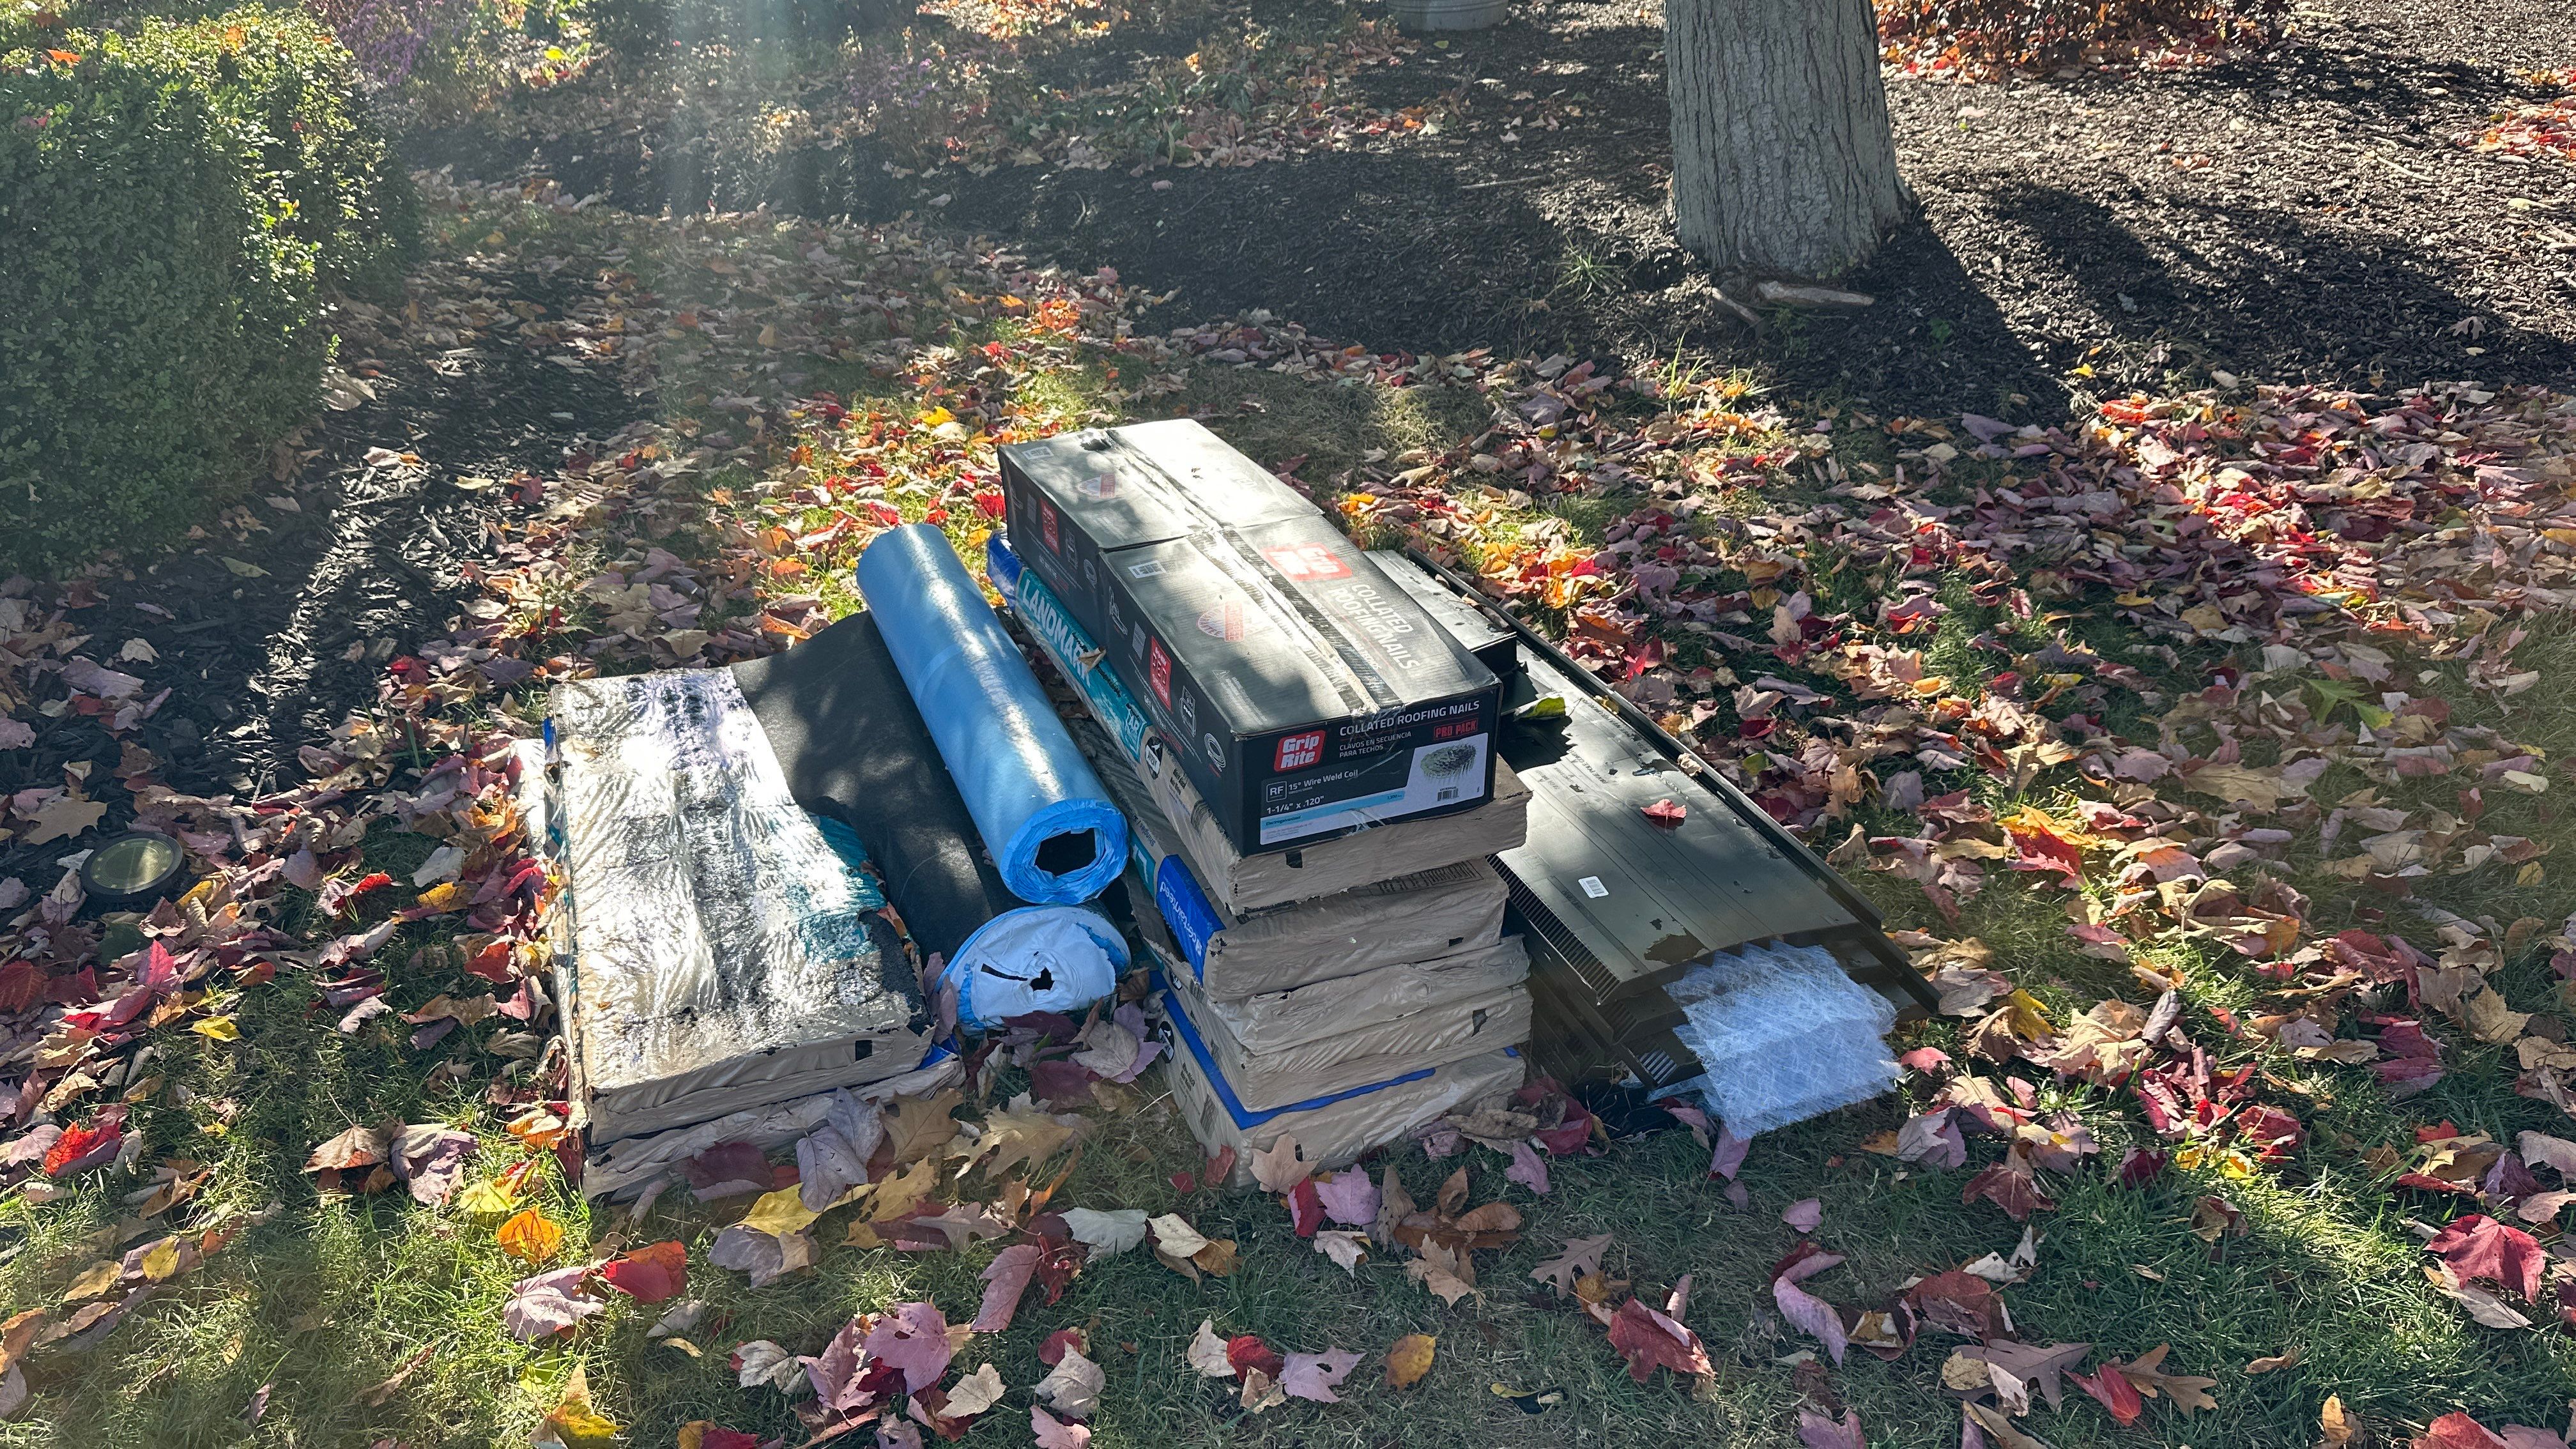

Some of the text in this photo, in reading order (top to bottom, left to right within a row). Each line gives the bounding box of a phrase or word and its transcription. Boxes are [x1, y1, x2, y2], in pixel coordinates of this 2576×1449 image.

[1352, 584, 1414, 634] COLLATED
[1328, 587, 1421, 670] ROOFING NAILS
[1340, 700, 1480, 737] COLLATED ROOFING NAILS
[1434, 719, 1478, 739] PRO PACK
[1282, 734, 1319, 754] Grip
[1339, 742, 1365, 751] CLAVOS
[1375, 731, 1412, 745] SECUENCIA
[1339, 744, 1384, 758] PARA TECHOS
[1280, 749, 1315, 769] Rite
[1288, 782, 1302, 791] 15°
[1303, 778, 1322, 787] Wire
[1322, 772, 1342, 783] Weld
[1344, 769, 1358, 778] Coil
[1269, 786, 1284, 796] RF
[1266, 802, 1294, 815] 1-1/4"
